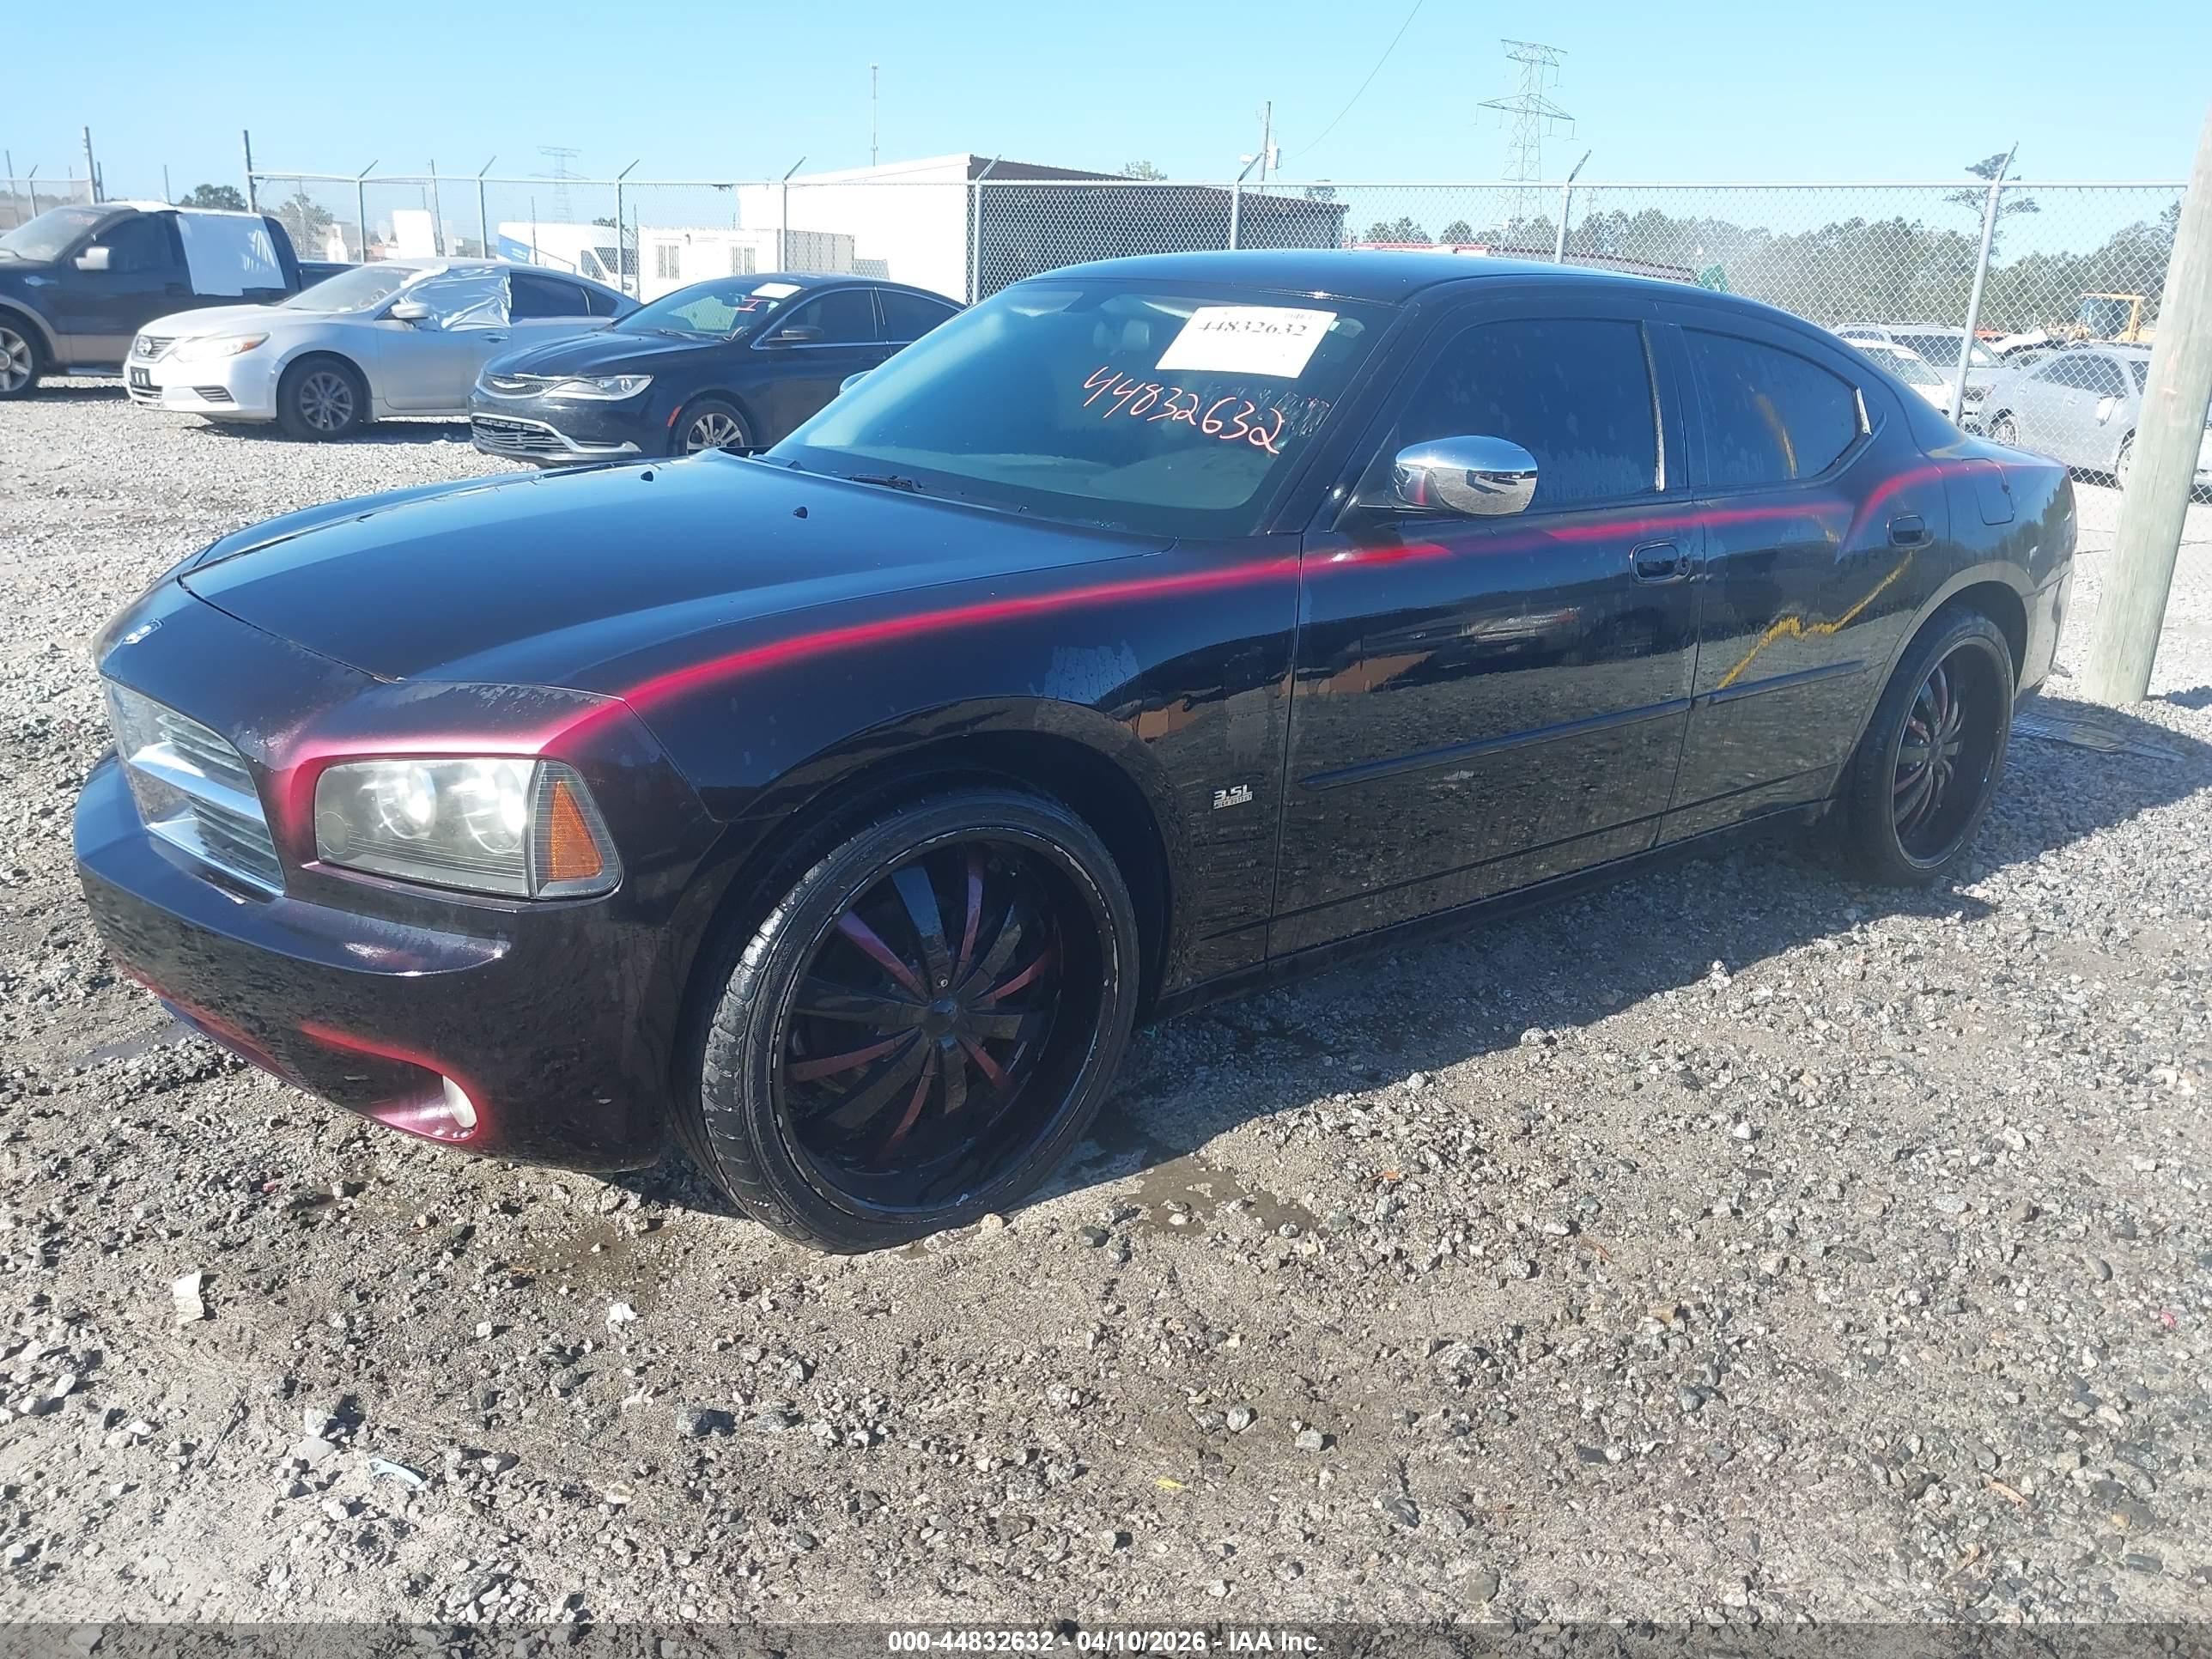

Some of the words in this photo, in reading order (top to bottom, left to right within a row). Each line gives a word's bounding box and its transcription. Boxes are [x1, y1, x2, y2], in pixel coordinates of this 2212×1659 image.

[1197, 320, 1308, 337] 44832632
[1083, 366, 1280, 454] 44832632
[1213, 783, 1253, 803] 3.5L
